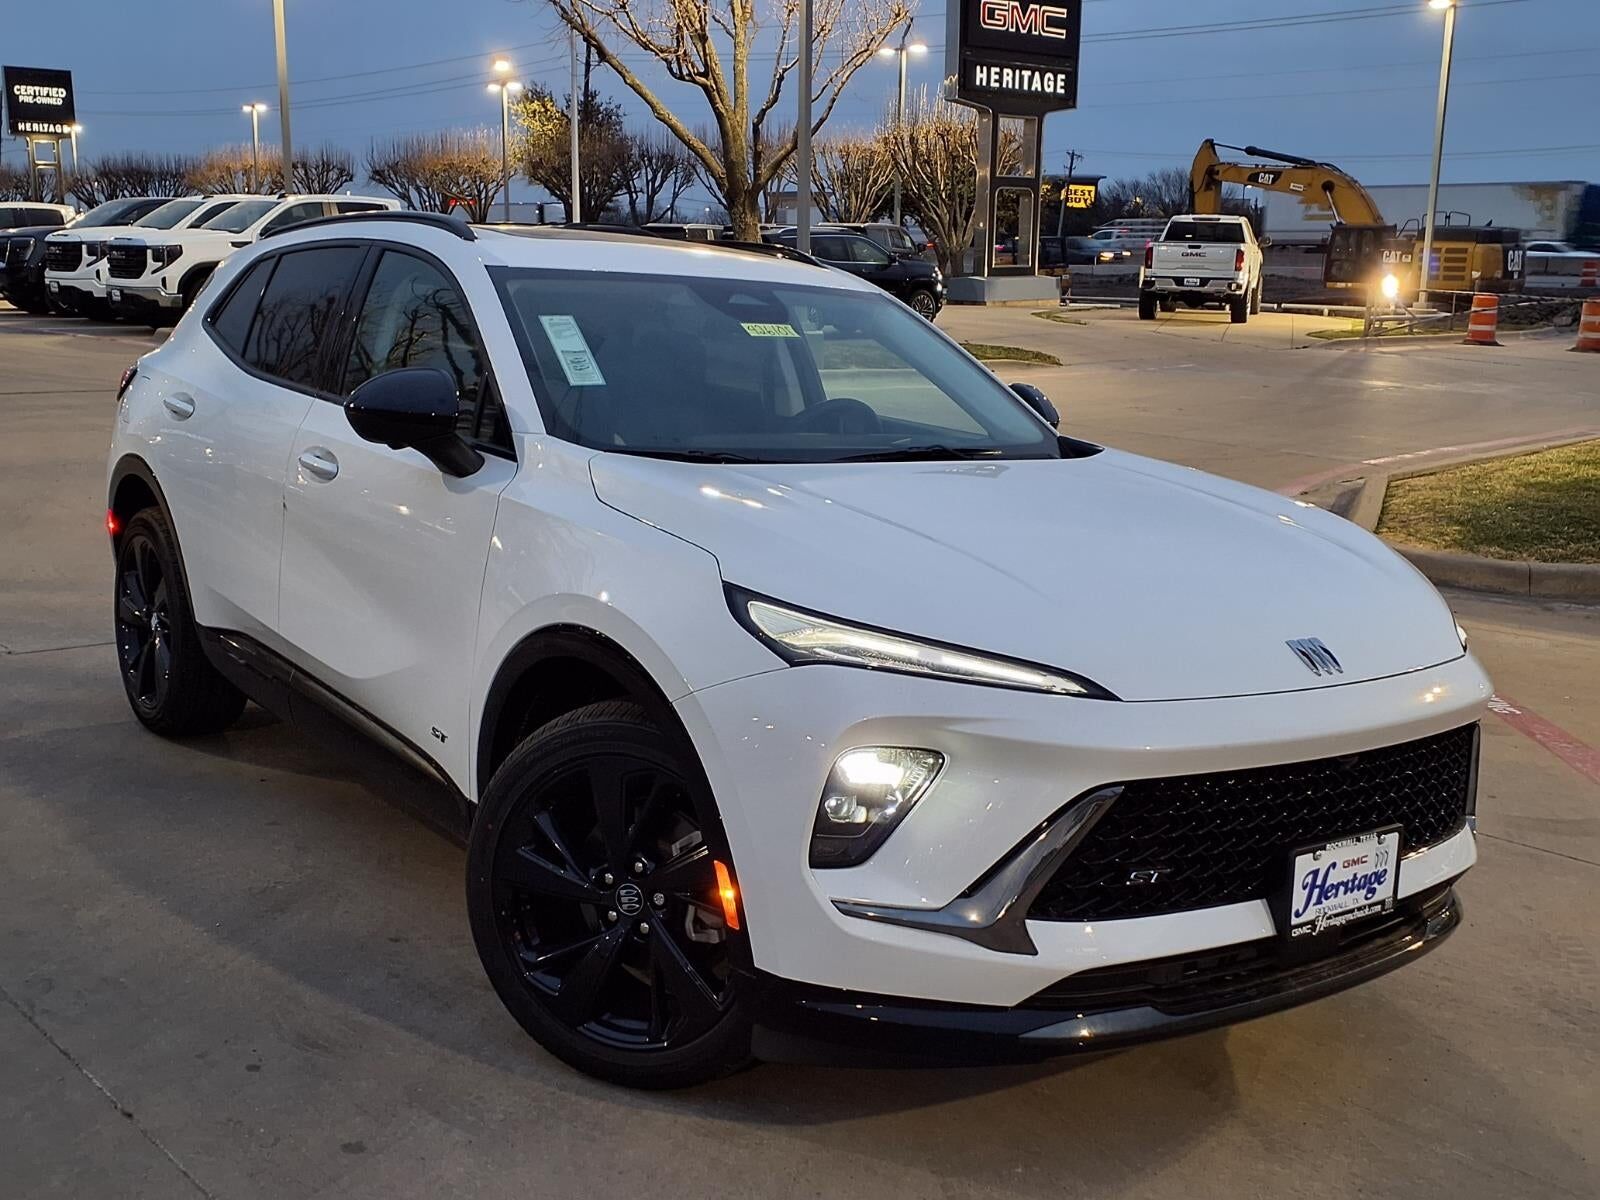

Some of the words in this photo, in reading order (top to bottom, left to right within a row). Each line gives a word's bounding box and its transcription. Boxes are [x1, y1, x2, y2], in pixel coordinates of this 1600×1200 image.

[980, 0, 1067, 39] GMC
[975, 64, 1066, 94] HERITAGE
[13, 84, 67, 98] CERTIFIED
[18, 95, 63, 106] PRE-OWNED
[1258, 172, 1275, 185] CAT
[1066, 188, 1093, 196] BEST
[1066, 196, 1090, 204] BUY
[1382, 250, 1402, 263] CAT
[1507, 249, 1523, 272] CAT
[1342, 854, 1369, 870] GMC
[1294, 861, 1388, 918] Heritage
[1291, 924, 1313, 937] GMC
